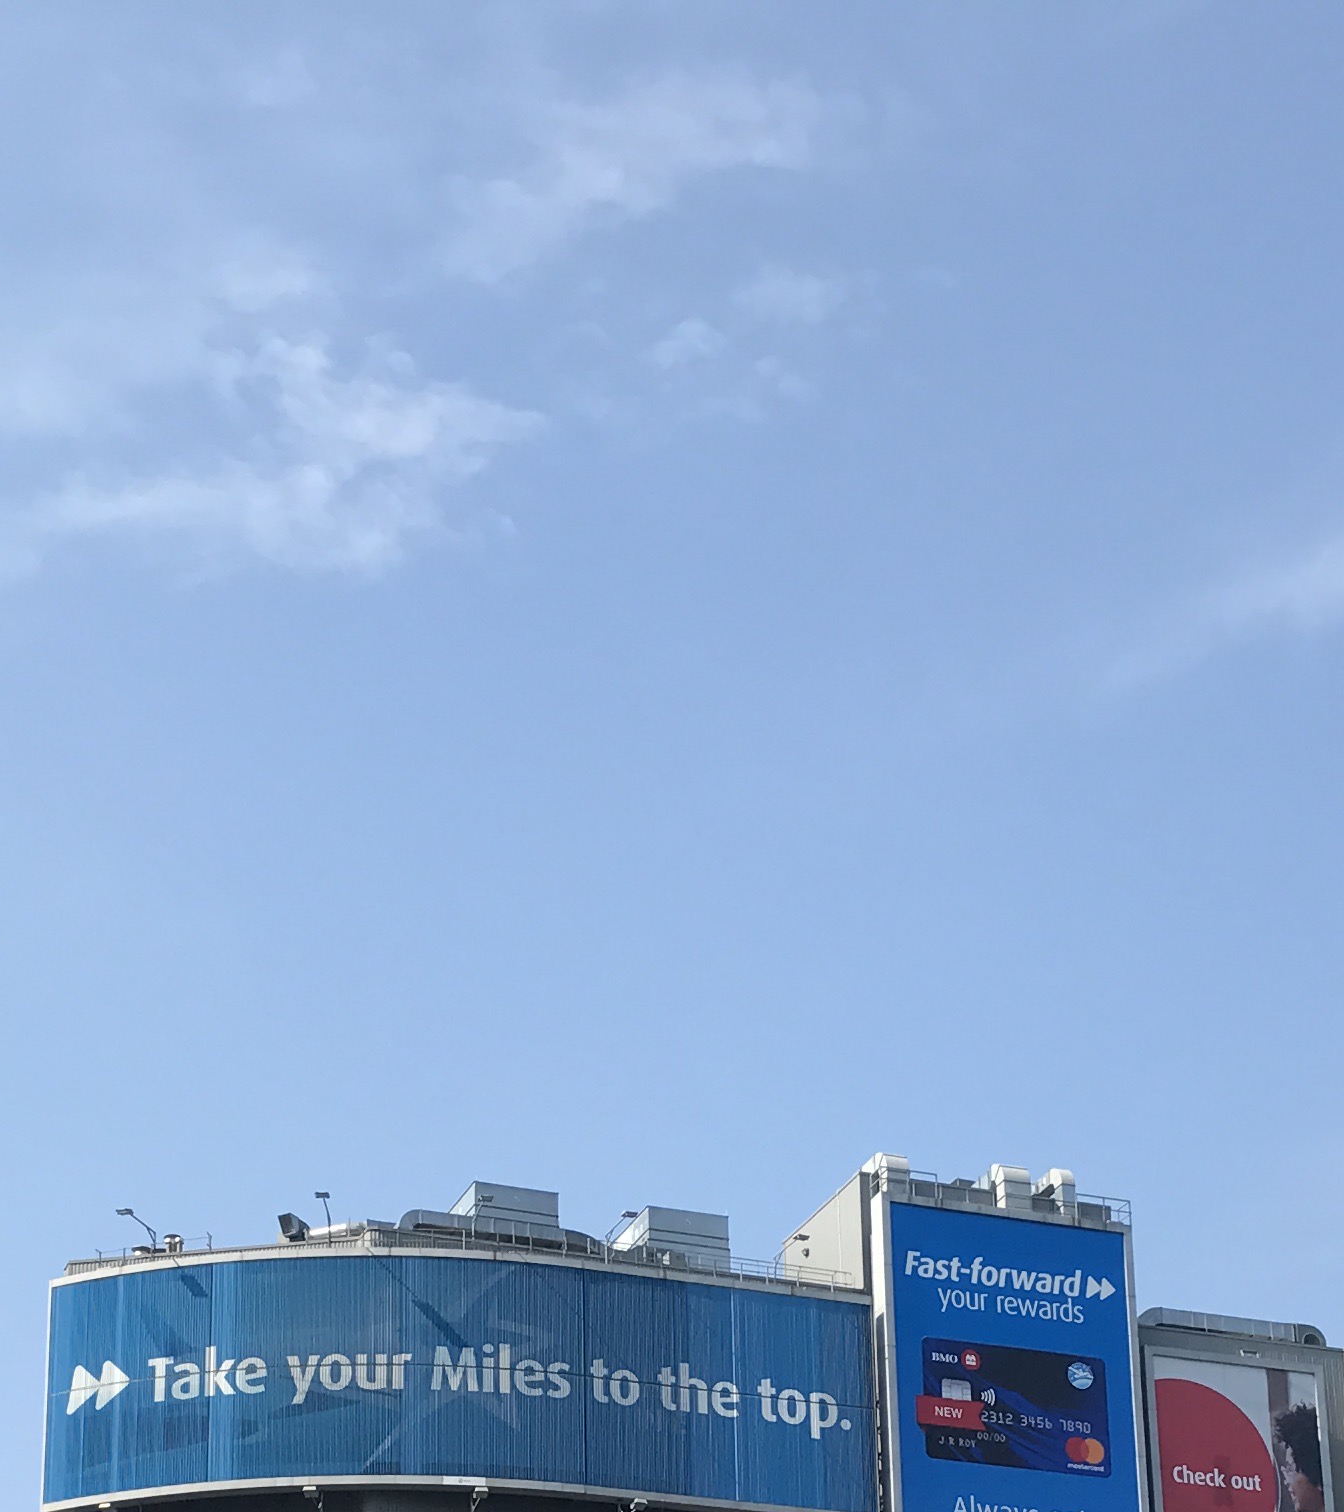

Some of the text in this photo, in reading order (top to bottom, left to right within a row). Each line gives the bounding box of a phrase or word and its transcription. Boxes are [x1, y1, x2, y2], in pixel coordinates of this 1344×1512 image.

[904, 1249, 1082, 1298] Fast-forward
[937, 1285, 1085, 1325] your rewards
[931, 1351, 959, 1365] BMO
[147, 1342, 853, 1441] Take your Miles to the top.
[934, 1405, 1092, 1435] NEW 2312 3456 7890
[958, 1438, 978, 1449] ROY
[976, 1431, 1007, 1444] 00/00
[1172, 1464, 1263, 1492] Check out
